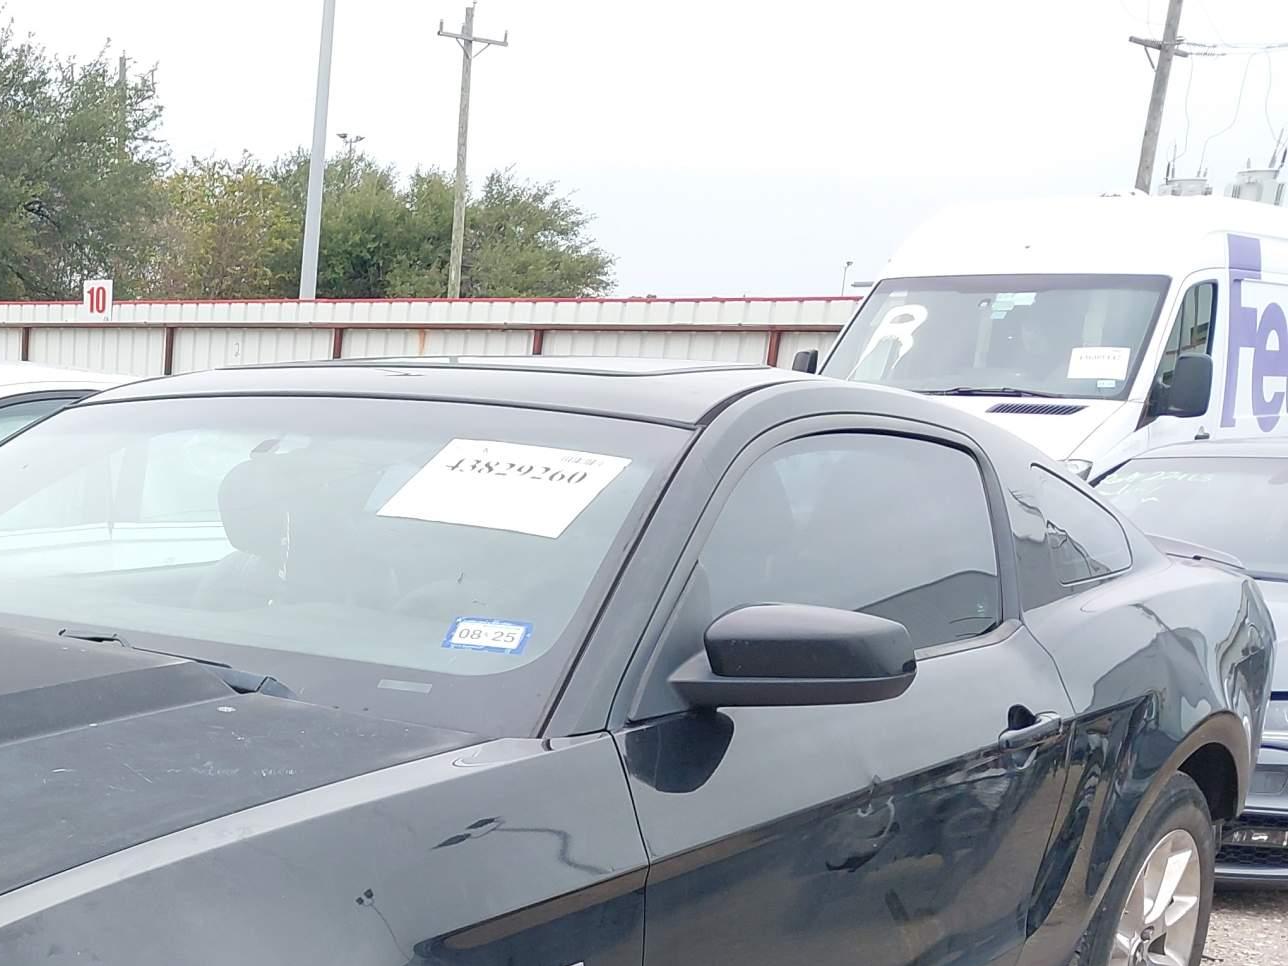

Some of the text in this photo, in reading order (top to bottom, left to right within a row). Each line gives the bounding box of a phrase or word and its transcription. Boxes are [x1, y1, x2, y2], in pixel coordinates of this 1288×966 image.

[87, 286, 106, 313] 10
[1220, 232, 1288, 433] Fe
[445, 457, 588, 484] 43829260
